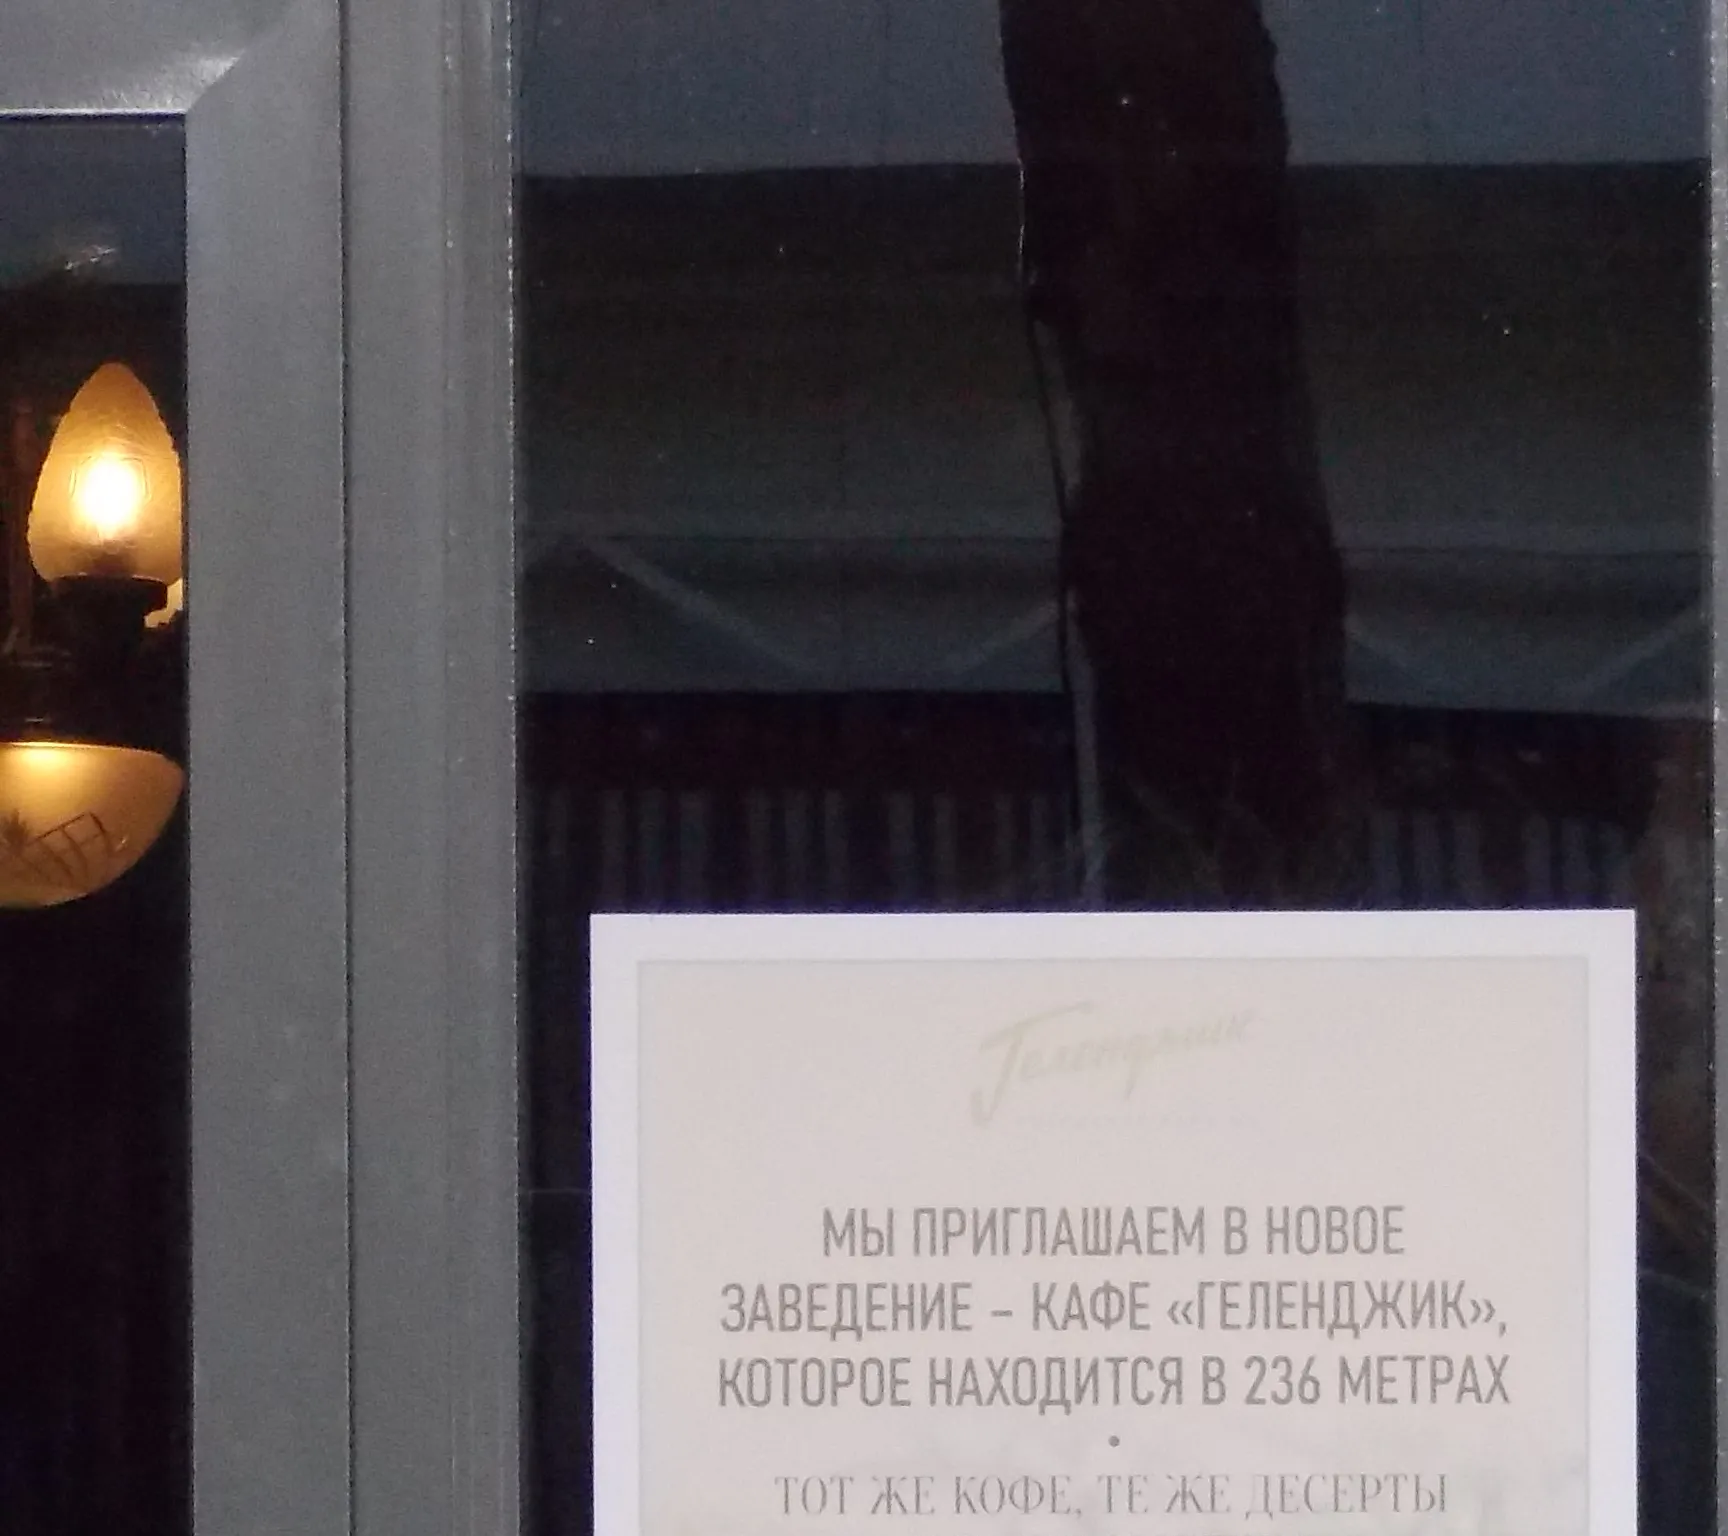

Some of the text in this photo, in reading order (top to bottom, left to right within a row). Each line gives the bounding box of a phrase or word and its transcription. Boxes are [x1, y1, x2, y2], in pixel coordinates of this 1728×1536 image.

[822, 1205, 1404, 1257] МЫ ПРИГЛАШАЕМ В НОВОЕ
[720, 1281, 973, 1339] ЗАВЕДЕНИЕ
[1032, 1280, 1150, 1332] КАФЕ
[1167, 1280, 1507, 1339] «ГЕЛЕНДЖИК»,
[718, 1354, 1510, 1413] КОТОРОЕ НАХОДИТСЯ В 236 МЕТРАХ
[775, 1472, 1447, 1523] ТОТ ЖЕ КОФЕ, ТЕ ЖЕ ДЕСЕРТЫ
